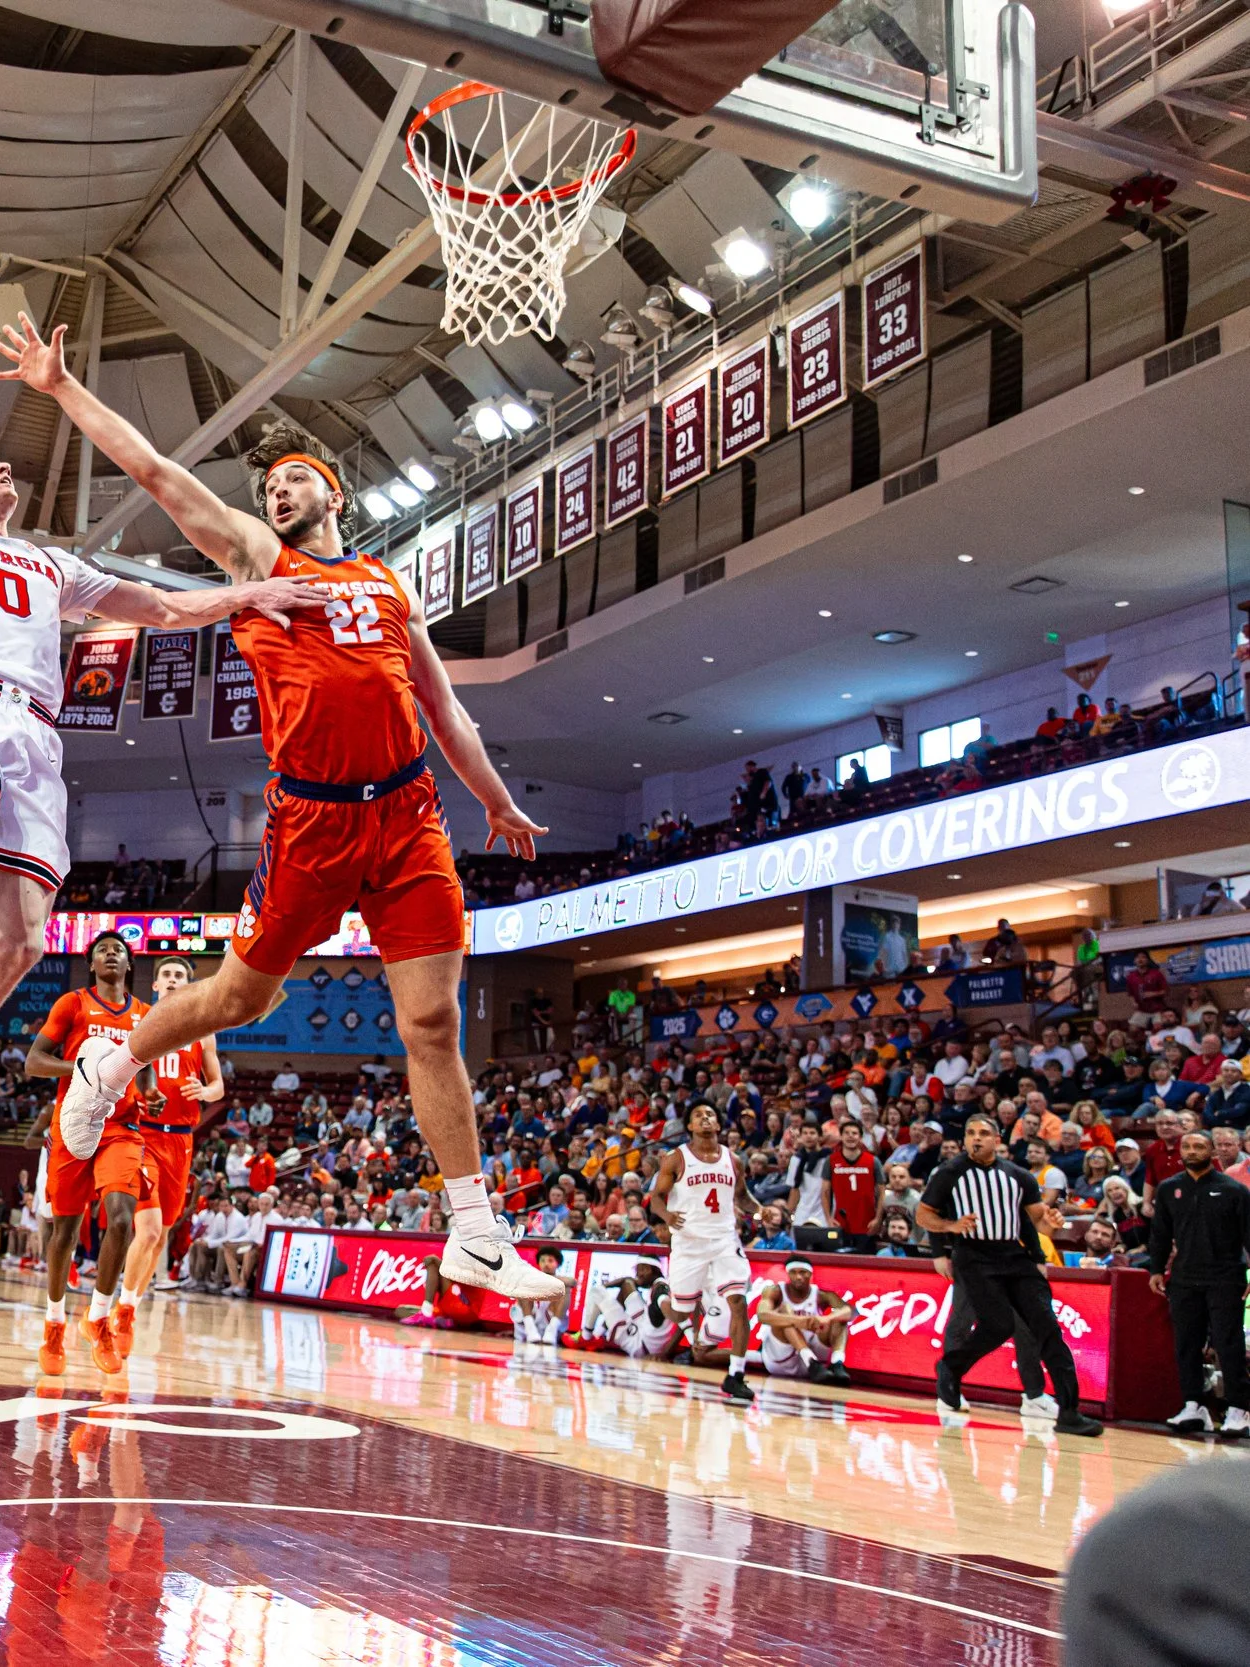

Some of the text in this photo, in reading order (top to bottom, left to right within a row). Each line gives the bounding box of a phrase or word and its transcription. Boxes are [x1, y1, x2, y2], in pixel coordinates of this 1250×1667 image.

[875, 281, 911, 311] LUMPKIN
[883, 273, 902, 294] JODY
[802, 317, 829, 342] SEDRIC
[879, 303, 907, 345] 33
[801, 328, 831, 354] WEBBER
[803, 348, 829, 389] 23
[732, 391, 755, 429] 20
[675, 426, 695, 462] 21
[616, 460, 636, 492] 42
[566, 491, 584, 523] 24
[515, 522, 531, 552] 10
[472, 546, 488, 575] 55
[430, 571, 445, 598] 44
[325, 595, 383, 644] 22
[90, 643, 115, 654] JOHN
[152, 636, 191, 654] NAIA
[82, 654, 118, 665] KRESSE
[58, 714, 113, 726] 1979-2002
[363, 784, 374, 800] C
[537, 761, 1129, 941] PALMETTO FLOOR COVERINGS
[969, 976, 1004, 989] PALMETTO
[971, 988, 1002, 1001] BRACKET
[88, 1024, 131, 1040] CLEMS
[662, 1017, 686, 1037] 2025
[158, 1053, 180, 1079] 10
[688, 1173, 733, 1187] GEORGIA
[834, 1166, 869, 1175] GEORGIA
[849, 1174, 857, 1191] 1
[704, 1188, 720, 1213] 4
